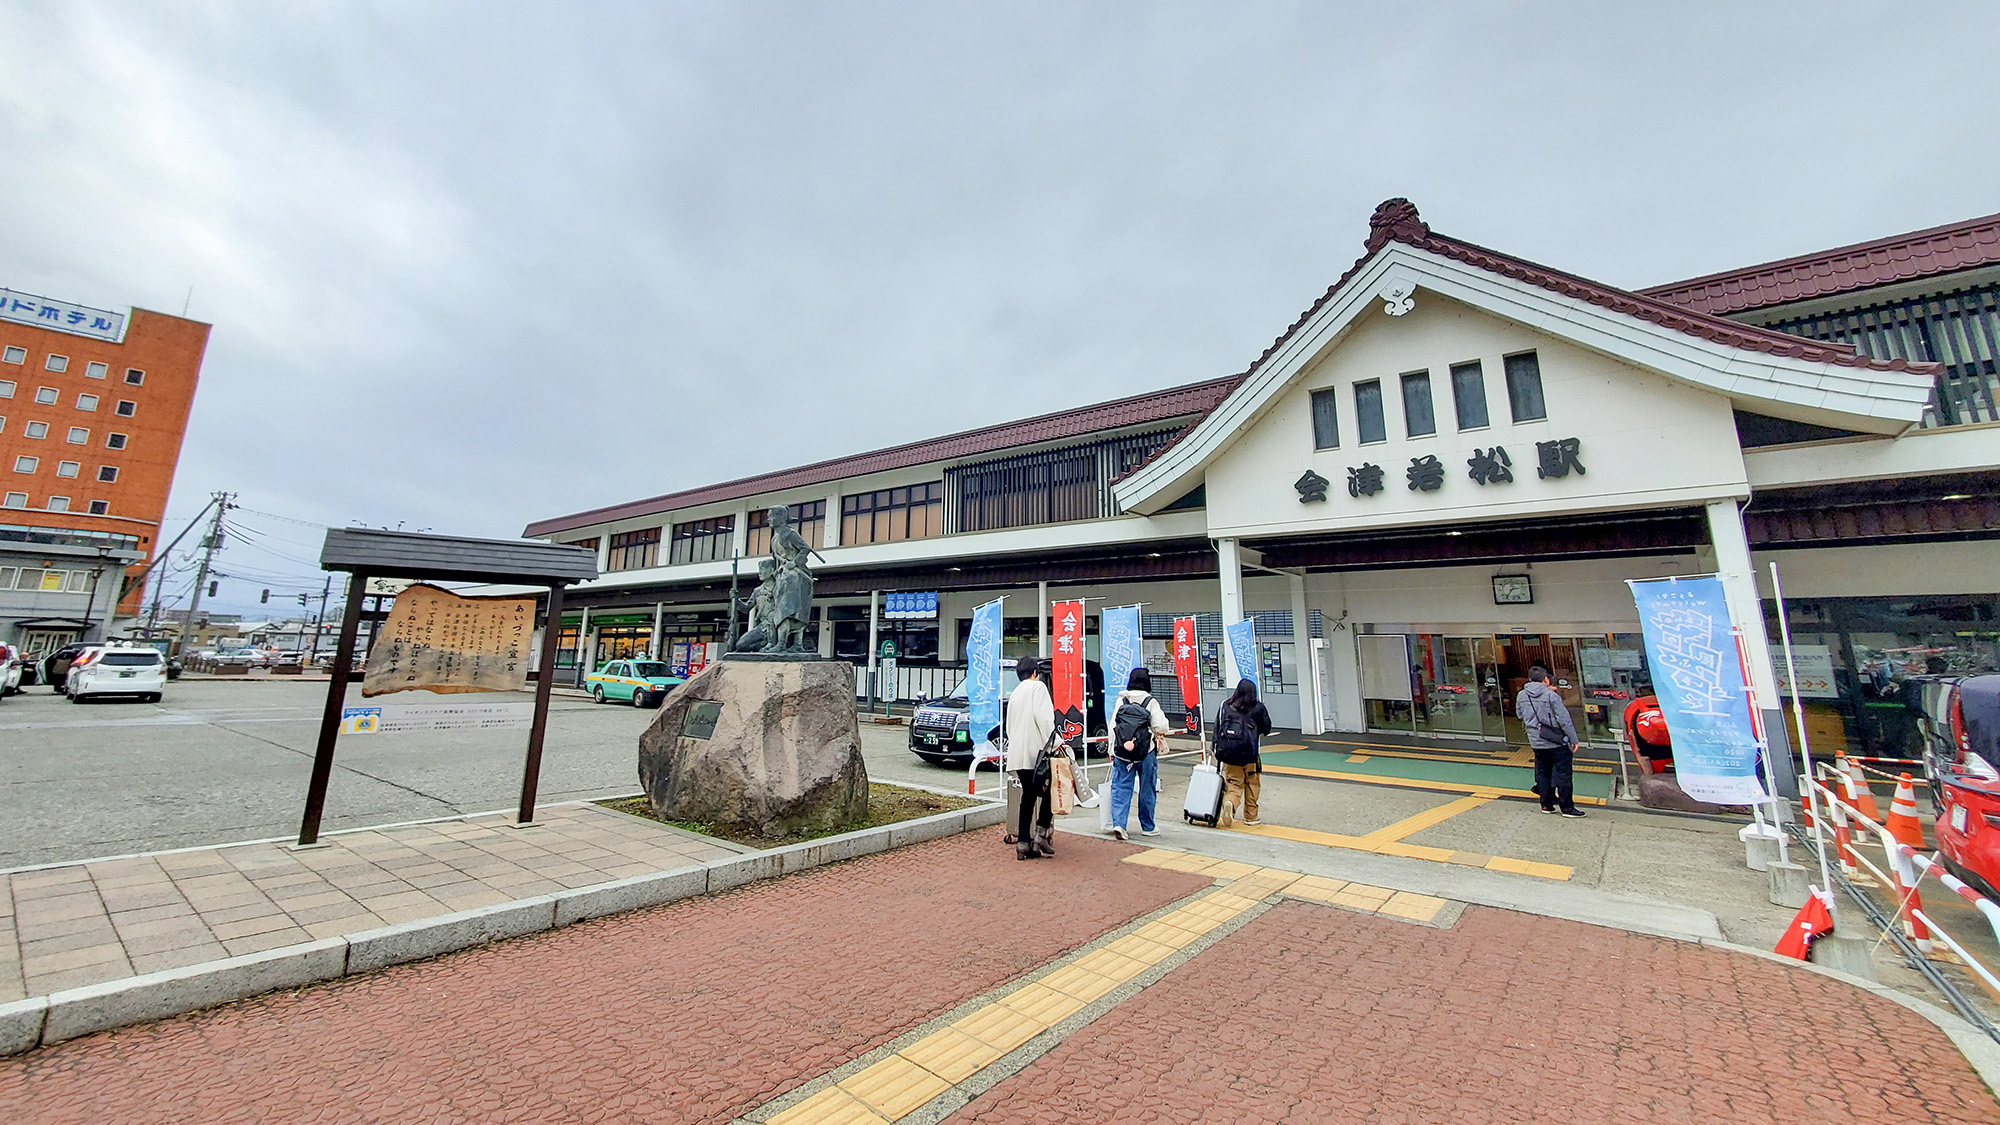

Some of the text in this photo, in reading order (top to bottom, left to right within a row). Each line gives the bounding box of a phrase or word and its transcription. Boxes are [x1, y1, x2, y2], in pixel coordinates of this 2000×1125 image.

[1294, 437, 1586, 504] 会津若松駅
[507, 605, 524, 671] あいづっこ宣言
[1177, 626, 1191, 661] 会津
